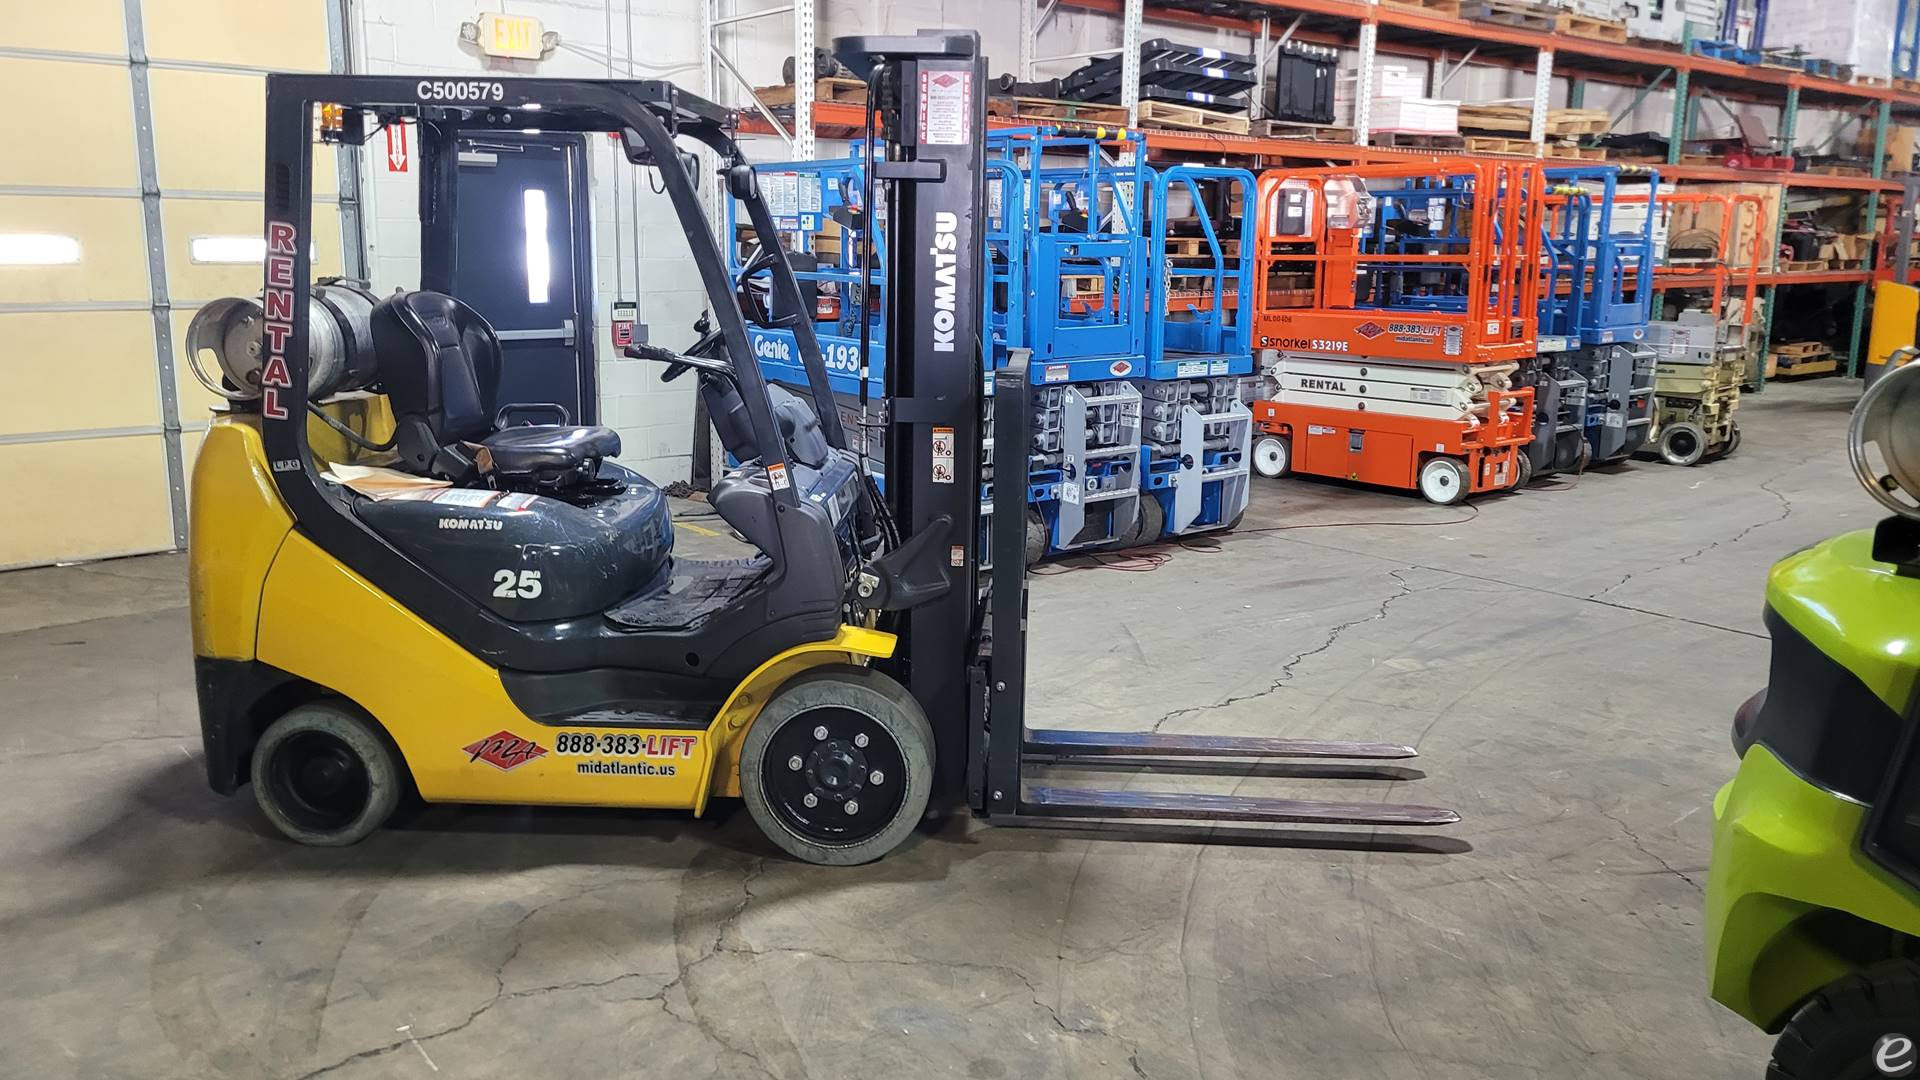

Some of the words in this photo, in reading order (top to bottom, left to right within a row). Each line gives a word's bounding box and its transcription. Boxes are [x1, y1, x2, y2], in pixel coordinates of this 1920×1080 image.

[495, 18, 530, 49] EXIT
[417, 81, 504, 100] C500579
[930, 212, 958, 352] KOMATSU
[262, 221, 296, 421] RENTAL
[754, 335, 791, 361] Genie
[1312, 339, 1349, 351] S3219E
[1301, 378, 1346, 391] RENTAL
[438, 518, 504, 531] KOMATSU
[493, 569, 543, 600] 25
[577, 761, 676, 777] midatlantic.us
